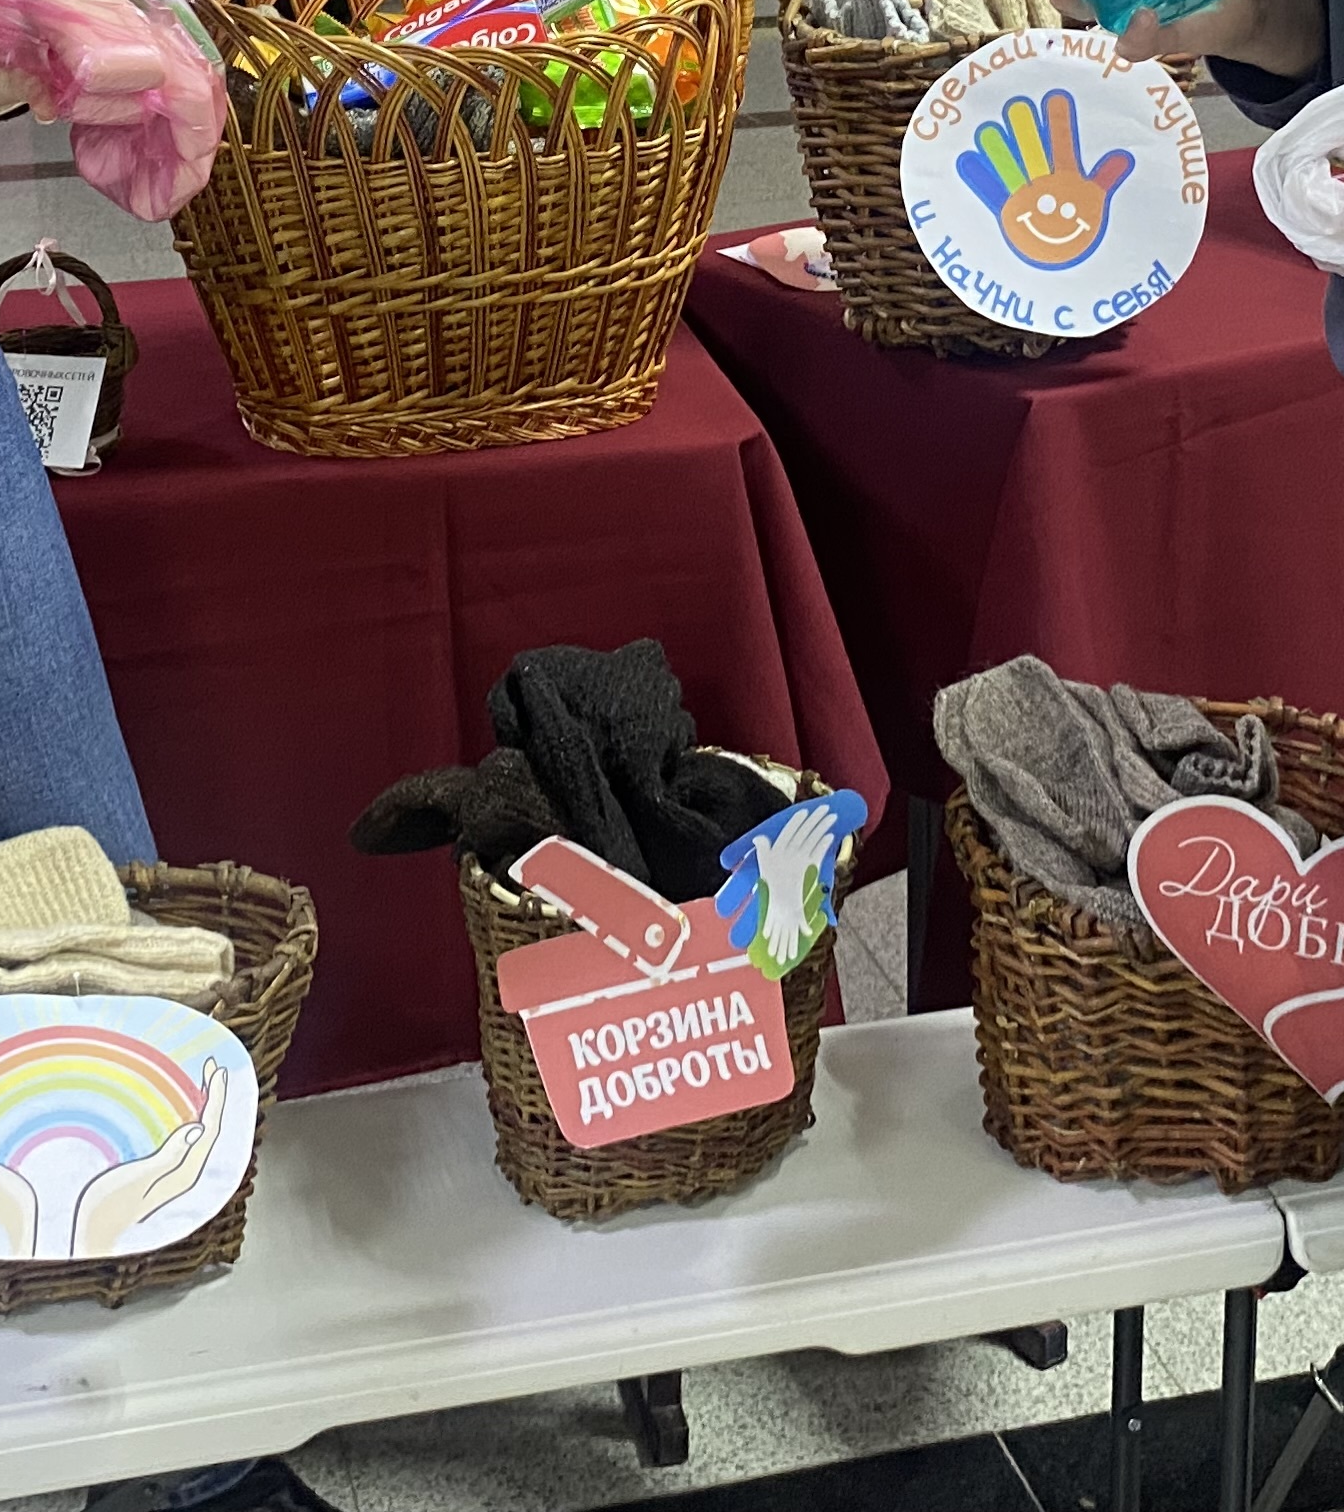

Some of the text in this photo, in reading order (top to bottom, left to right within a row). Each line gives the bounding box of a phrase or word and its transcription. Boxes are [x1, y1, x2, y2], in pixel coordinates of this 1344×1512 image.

[451, 22, 537, 49] Colg
[1146, 82, 1205, 206] лучше
[1159, 835, 1329, 934] Дари
[568, 990, 756, 1070] КОРЗИНА
[578, 1034, 772, 1126] ДОБРОТЫ
